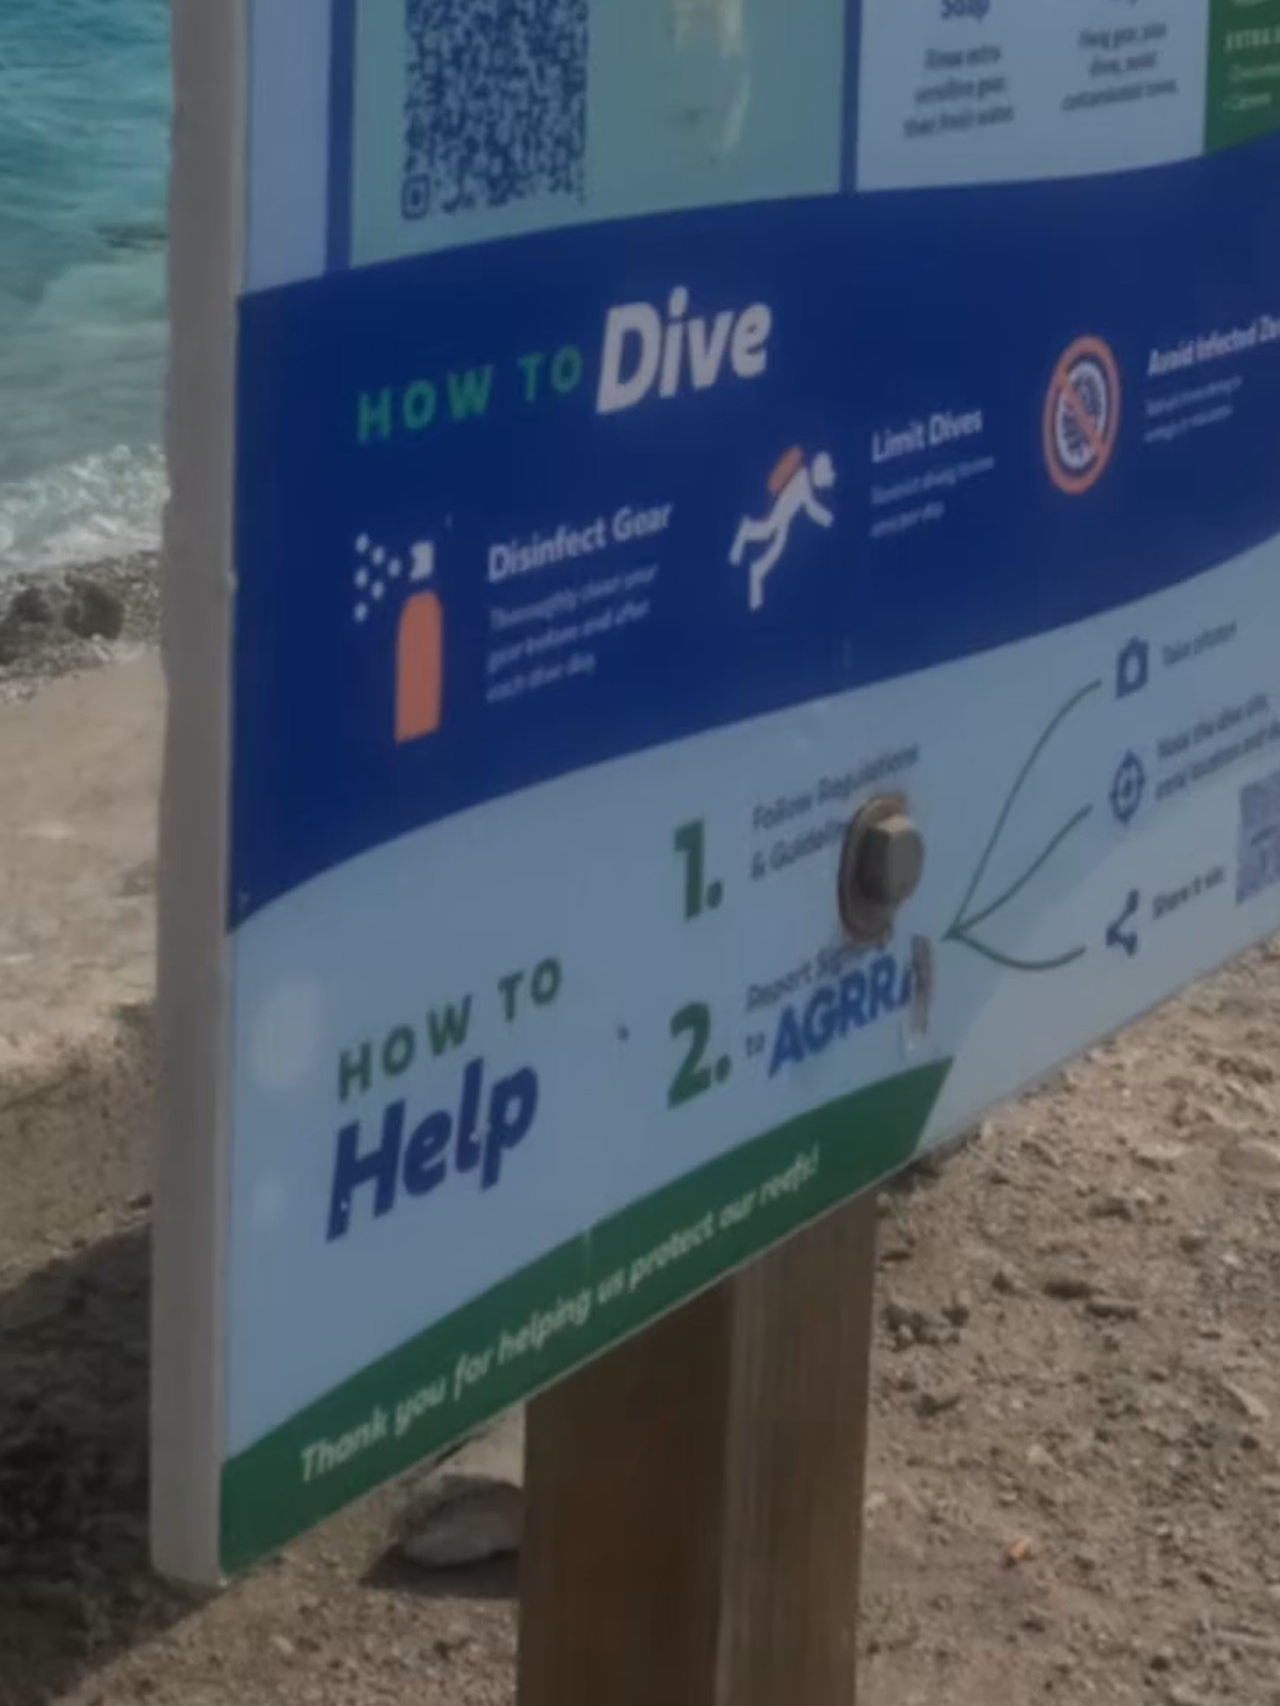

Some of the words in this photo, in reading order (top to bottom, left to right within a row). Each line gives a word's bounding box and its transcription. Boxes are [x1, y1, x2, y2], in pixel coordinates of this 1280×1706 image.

[357, 364, 493, 443] HOW
[518, 345, 582, 402] TO
[596, 285, 772, 414] Dive
[871, 419, 925, 463] Limit
[928, 410, 983, 446] Dives
[487, 518, 606, 583] Disinfect
[612, 503, 673, 543] Gear
[752, 794, 813, 830] Follow
[672, 819, 723, 922] 1.
[337, 992, 473, 1103] HOW
[497, 956, 563, 1023] TO
[667, 1001, 731, 1110] 2.
[326, 1056, 539, 1243] Help
[301, 1403, 389, 1483] Thank
[394, 1376, 447, 1438] you
[453, 1345, 494, 1402] for
[497, 1286, 592, 1366] helping
[596, 1267, 626, 1306] us
[628, 1210, 714, 1294] protect
[719, 1190, 757, 1232] our
[759, 1140, 819, 1207] reefs!
